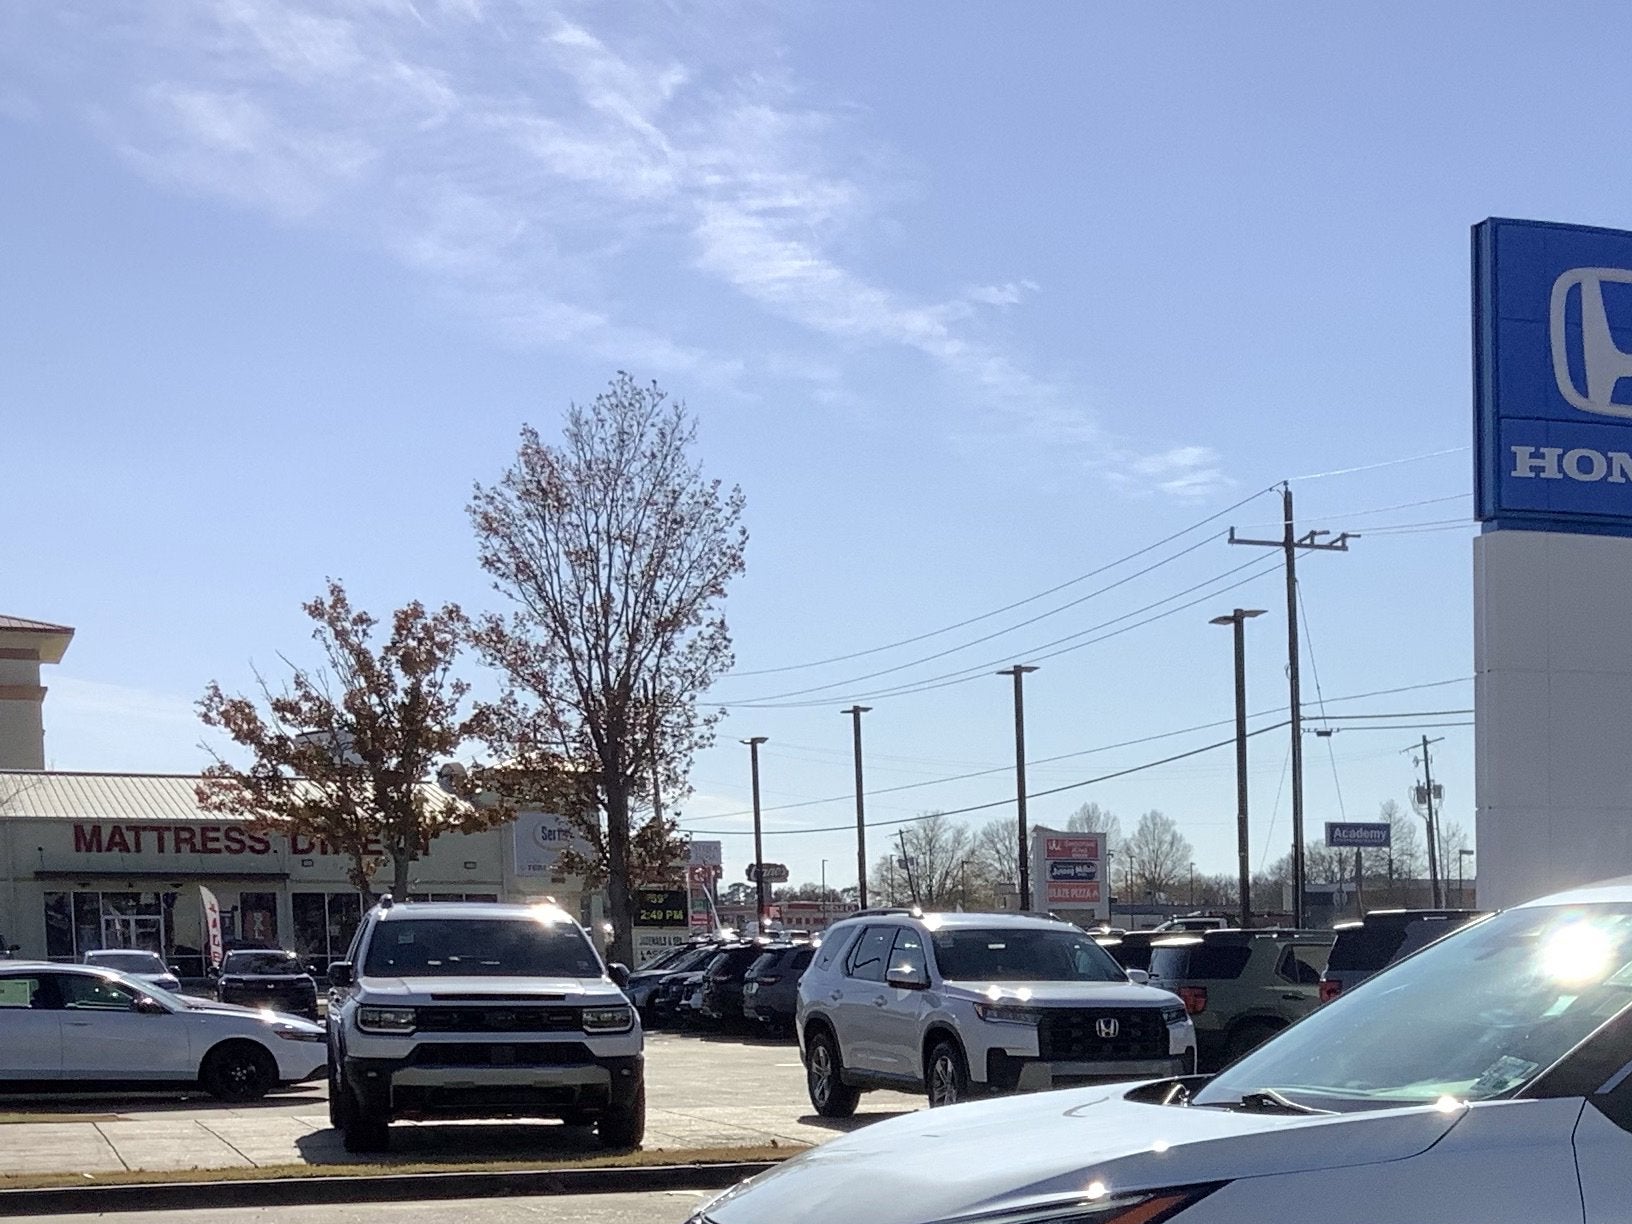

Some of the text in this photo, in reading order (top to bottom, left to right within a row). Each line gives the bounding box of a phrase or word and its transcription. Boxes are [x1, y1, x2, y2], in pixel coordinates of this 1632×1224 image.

[73, 822, 270, 855] MATTRESS
[1333, 827, 1387, 841] Academy
[640, 910, 684, 920] 2:49 PM
